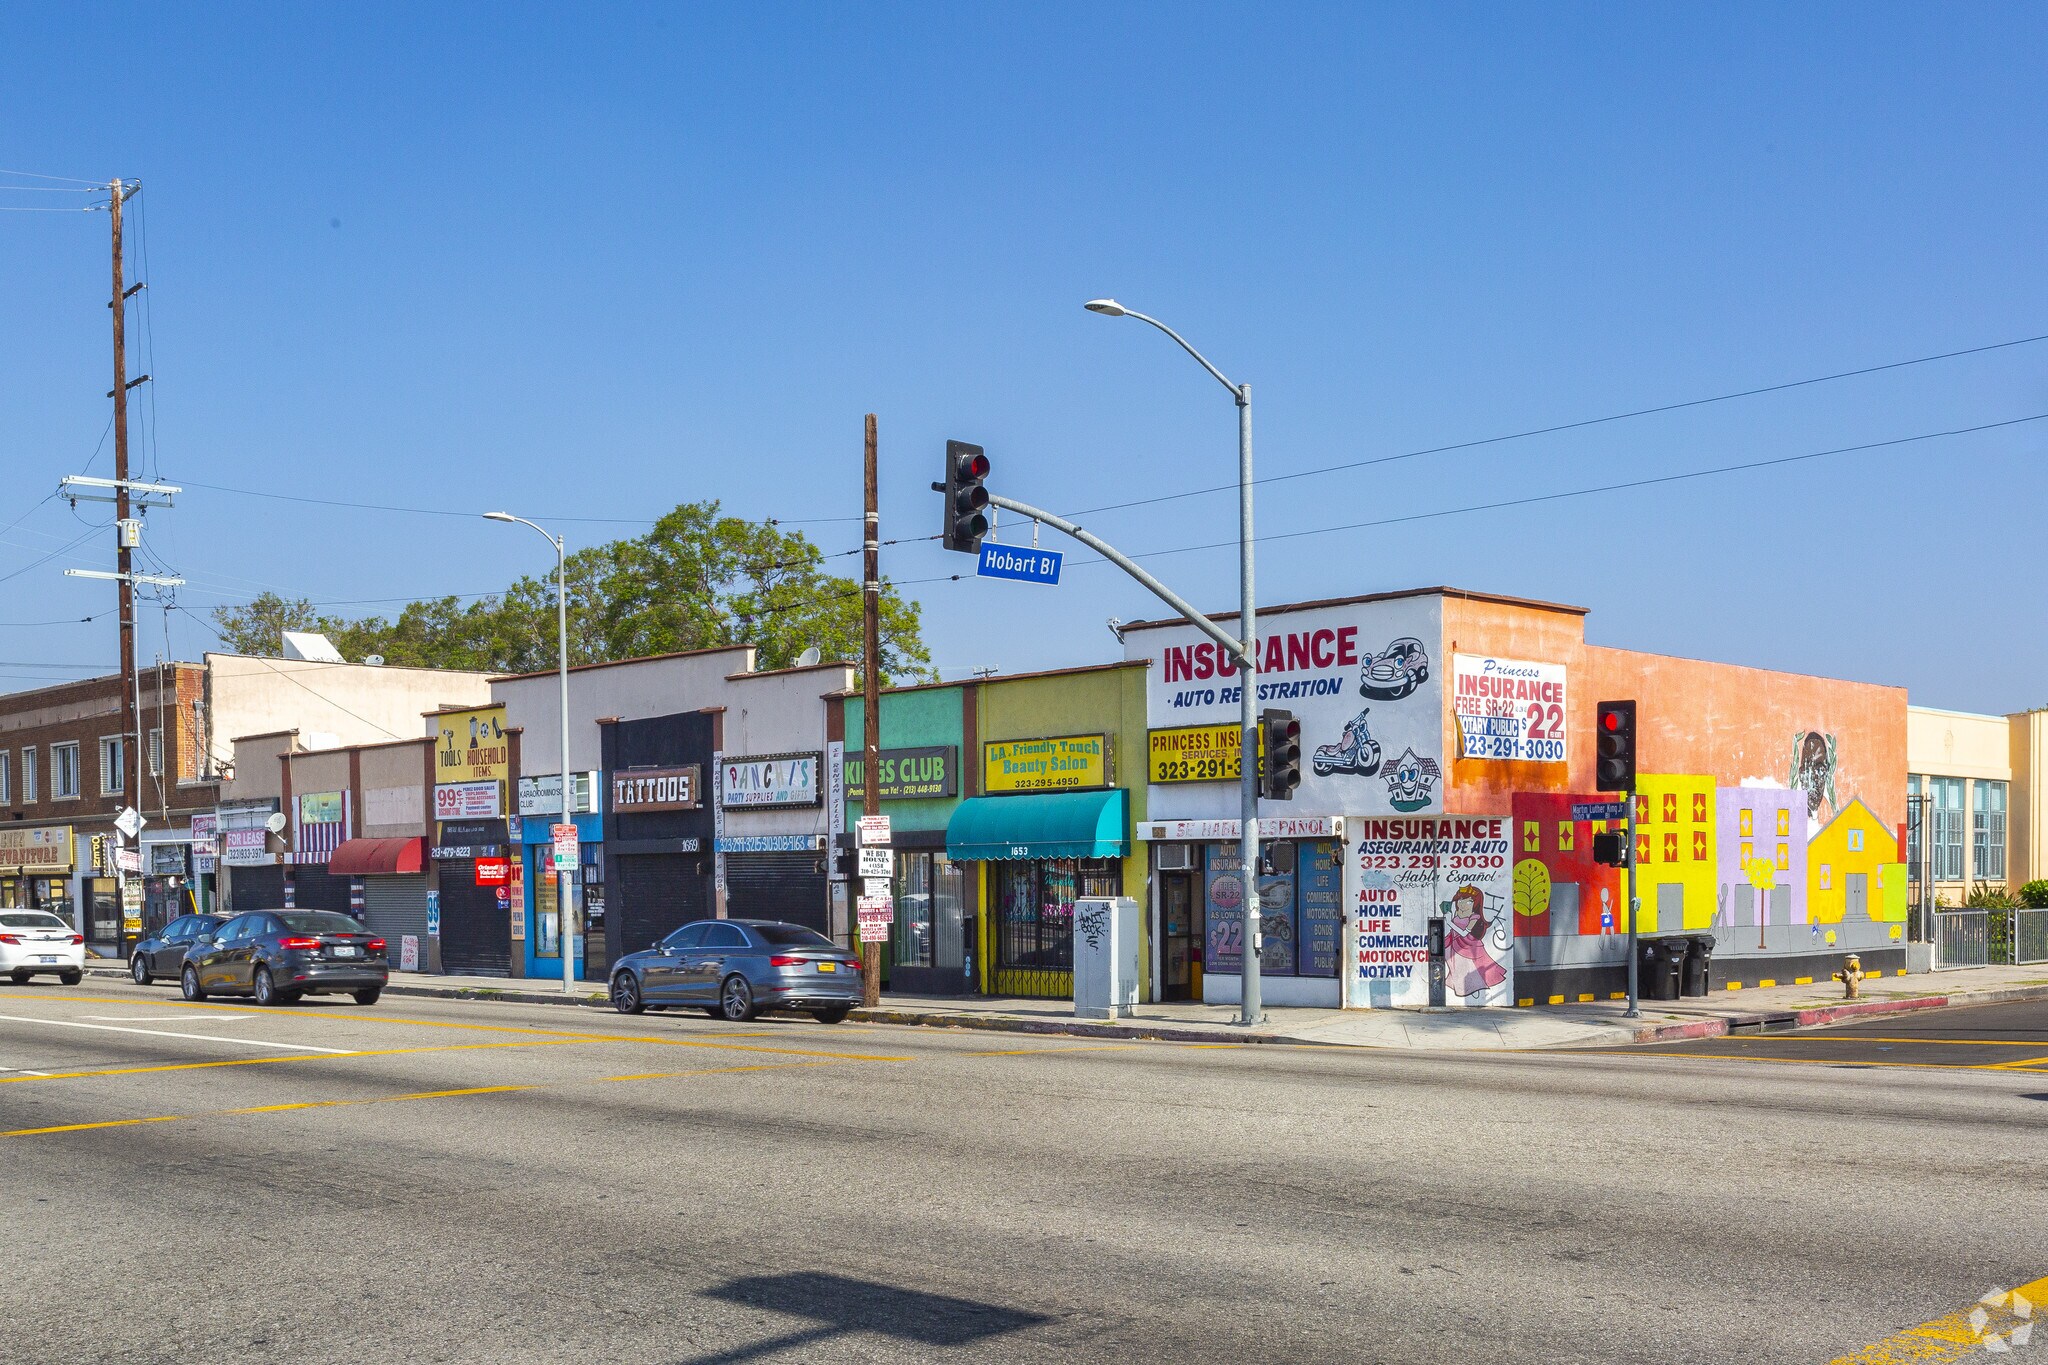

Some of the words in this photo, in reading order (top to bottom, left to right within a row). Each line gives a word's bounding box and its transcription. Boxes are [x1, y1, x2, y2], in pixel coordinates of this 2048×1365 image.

[986, 550, 1036, 573] Hobart
[1040, 557, 1055, 576] Bl
[1484, 659, 1539, 677] Princess
[1459, 674, 1562, 703] INSURANCE
[1174, 689, 1215, 708] AUTO
[1456, 696, 1481, 715] FREE
[1486, 698, 1514, 717] SR-22
[1491, 719, 1519, 737] PUBLIC
[1013, 741, 1056, 756] Friendly
[1060, 740, 1100, 755] Touch
[1152, 732, 1210, 752] PRINCESS
[440, 750, 461, 767] TOOLS
[467, 746, 506, 766] HOUSEHOLD
[900, 757, 945, 782] CLUB
[1003, 758, 1048, 775] Beauty
[1051, 756, 1088, 771] Salon
[729, 760, 808, 790] PANCHI'S
[832, 762, 840, 794] RENTAN
[1015, 777, 1079, 788] 323-295-4950
[617, 776, 689, 804] TATTOOS
[728, 792, 744, 803] PARTY
[746, 792, 773, 802] SUPPLIES
[776, 791, 788, 801] AND
[790, 790, 808, 800] GIFTS
[1573, 805, 1588, 814] Martin
[1590, 805, 1605, 813] Luther
[1606, 804, 1617, 815] King
[1202, 822, 1240, 837] HABL
[1365, 820, 1502, 839] INSURANCE
[228, 833, 241, 845] FOR
[243, 832, 265, 844] LEASE
[682, 839, 698, 852] 1659
[92, 837, 101, 867] OPEN
[1011, 847, 1028, 855] 1653
[1220, 845, 1236, 856] AUTO
[1317, 843, 1331, 854] AUTO
[1358, 840, 1449, 854] ASEGURANZA
[1452, 840, 1470, 854] DE
[1471, 840, 1508, 854] AUTO
[0, 847, 57, 864] FURNITURE
[201, 858, 214, 868] EBT
[1210, 858, 1241, 870] INSURANC
[1315, 859, 1331, 870] HOME
[1317, 876, 1328, 886] LIFE
[1446, 870, 1496, 884] Español
[1359, 889, 1397, 902] AUTO
[1359, 905, 1401, 917] HOME
[1314, 924, 1332, 935] BONDS
[1359, 920, 1391, 932] LIFE
[1312, 941, 1334, 951] NOTARY
[1314, 957, 1334, 968] PUBLIC
[1359, 965, 1413, 978] NOTARY
